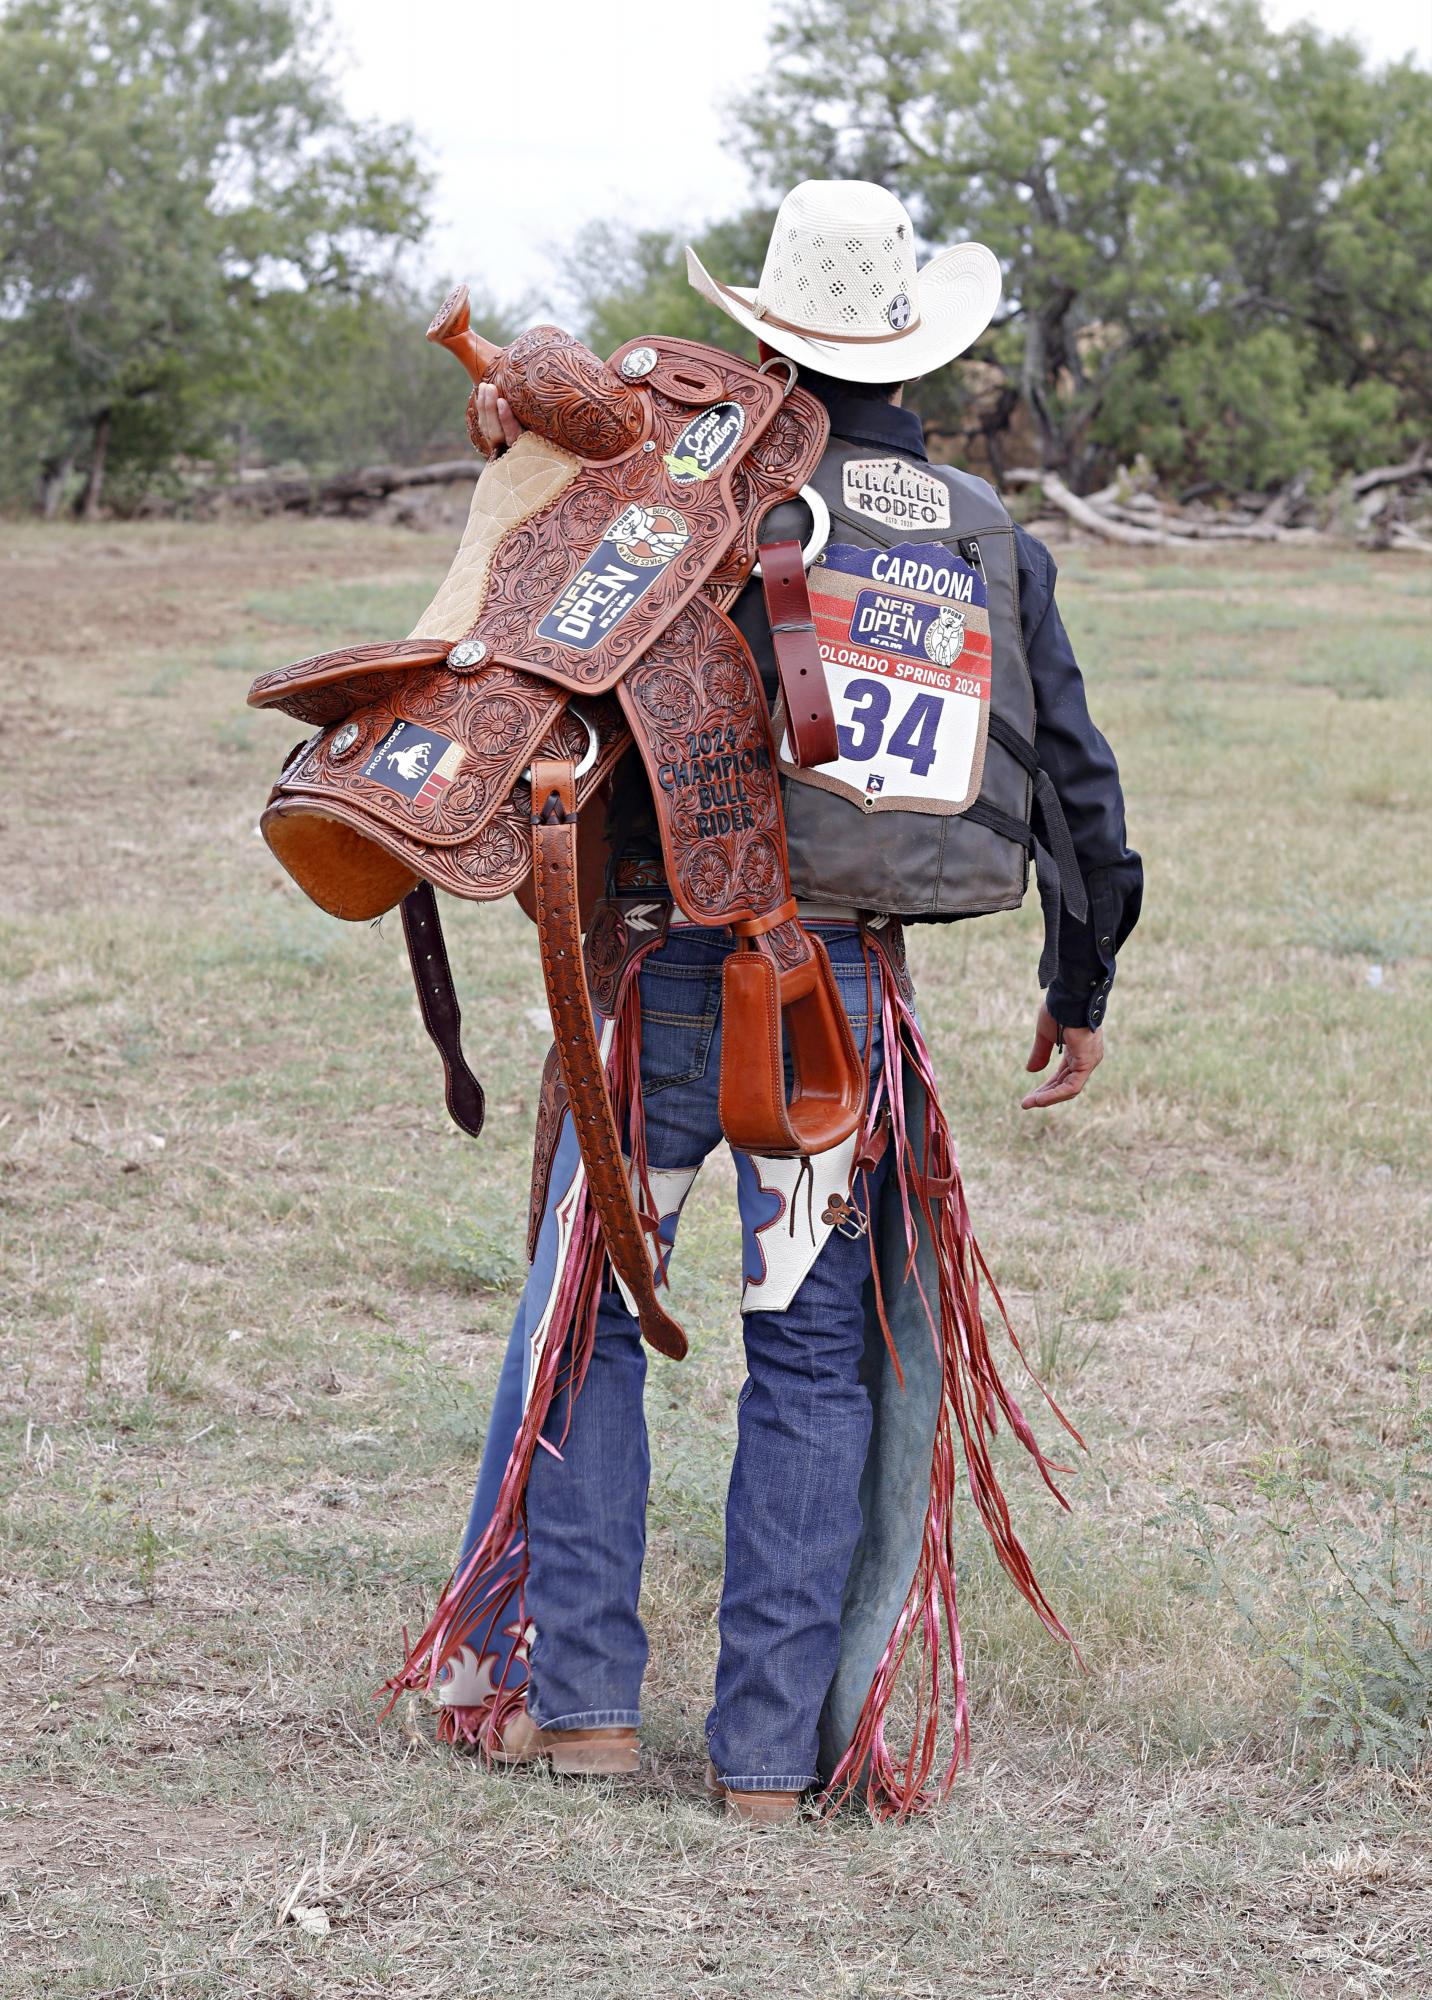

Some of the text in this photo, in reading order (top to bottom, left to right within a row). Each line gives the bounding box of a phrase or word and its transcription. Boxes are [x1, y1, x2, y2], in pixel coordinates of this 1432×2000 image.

[685, 412, 720, 450] Cactus
[695, 416, 739, 466] Saddlery
[848, 470, 945, 506] KRAKEN
[607, 510, 635, 537] PPOBR
[860, 493, 937, 523] RODEO
[622, 549, 639, 564] PEAK
[640, 557, 663, 566] PIKES
[552, 571, 597, 618] NFR
[871, 554, 974, 603] CARDONA
[557, 564, 639, 640] OPEN
[599, 592, 635, 628] RAM
[875, 596, 915, 616] NFR
[858, 607, 922, 646] OPEN
[870, 637, 902, 650] RAM
[818, 644, 981, 697] OLORADO SPRINGS 2024
[687, 727, 736, 758] 2024
[837, 679, 945, 777] 34
[365, 722, 406, 776] PRORODEO
[658, 745, 771, 791] CHAMPION
[699, 779, 748, 810] BULL
[696, 805, 755, 838] RIDER
